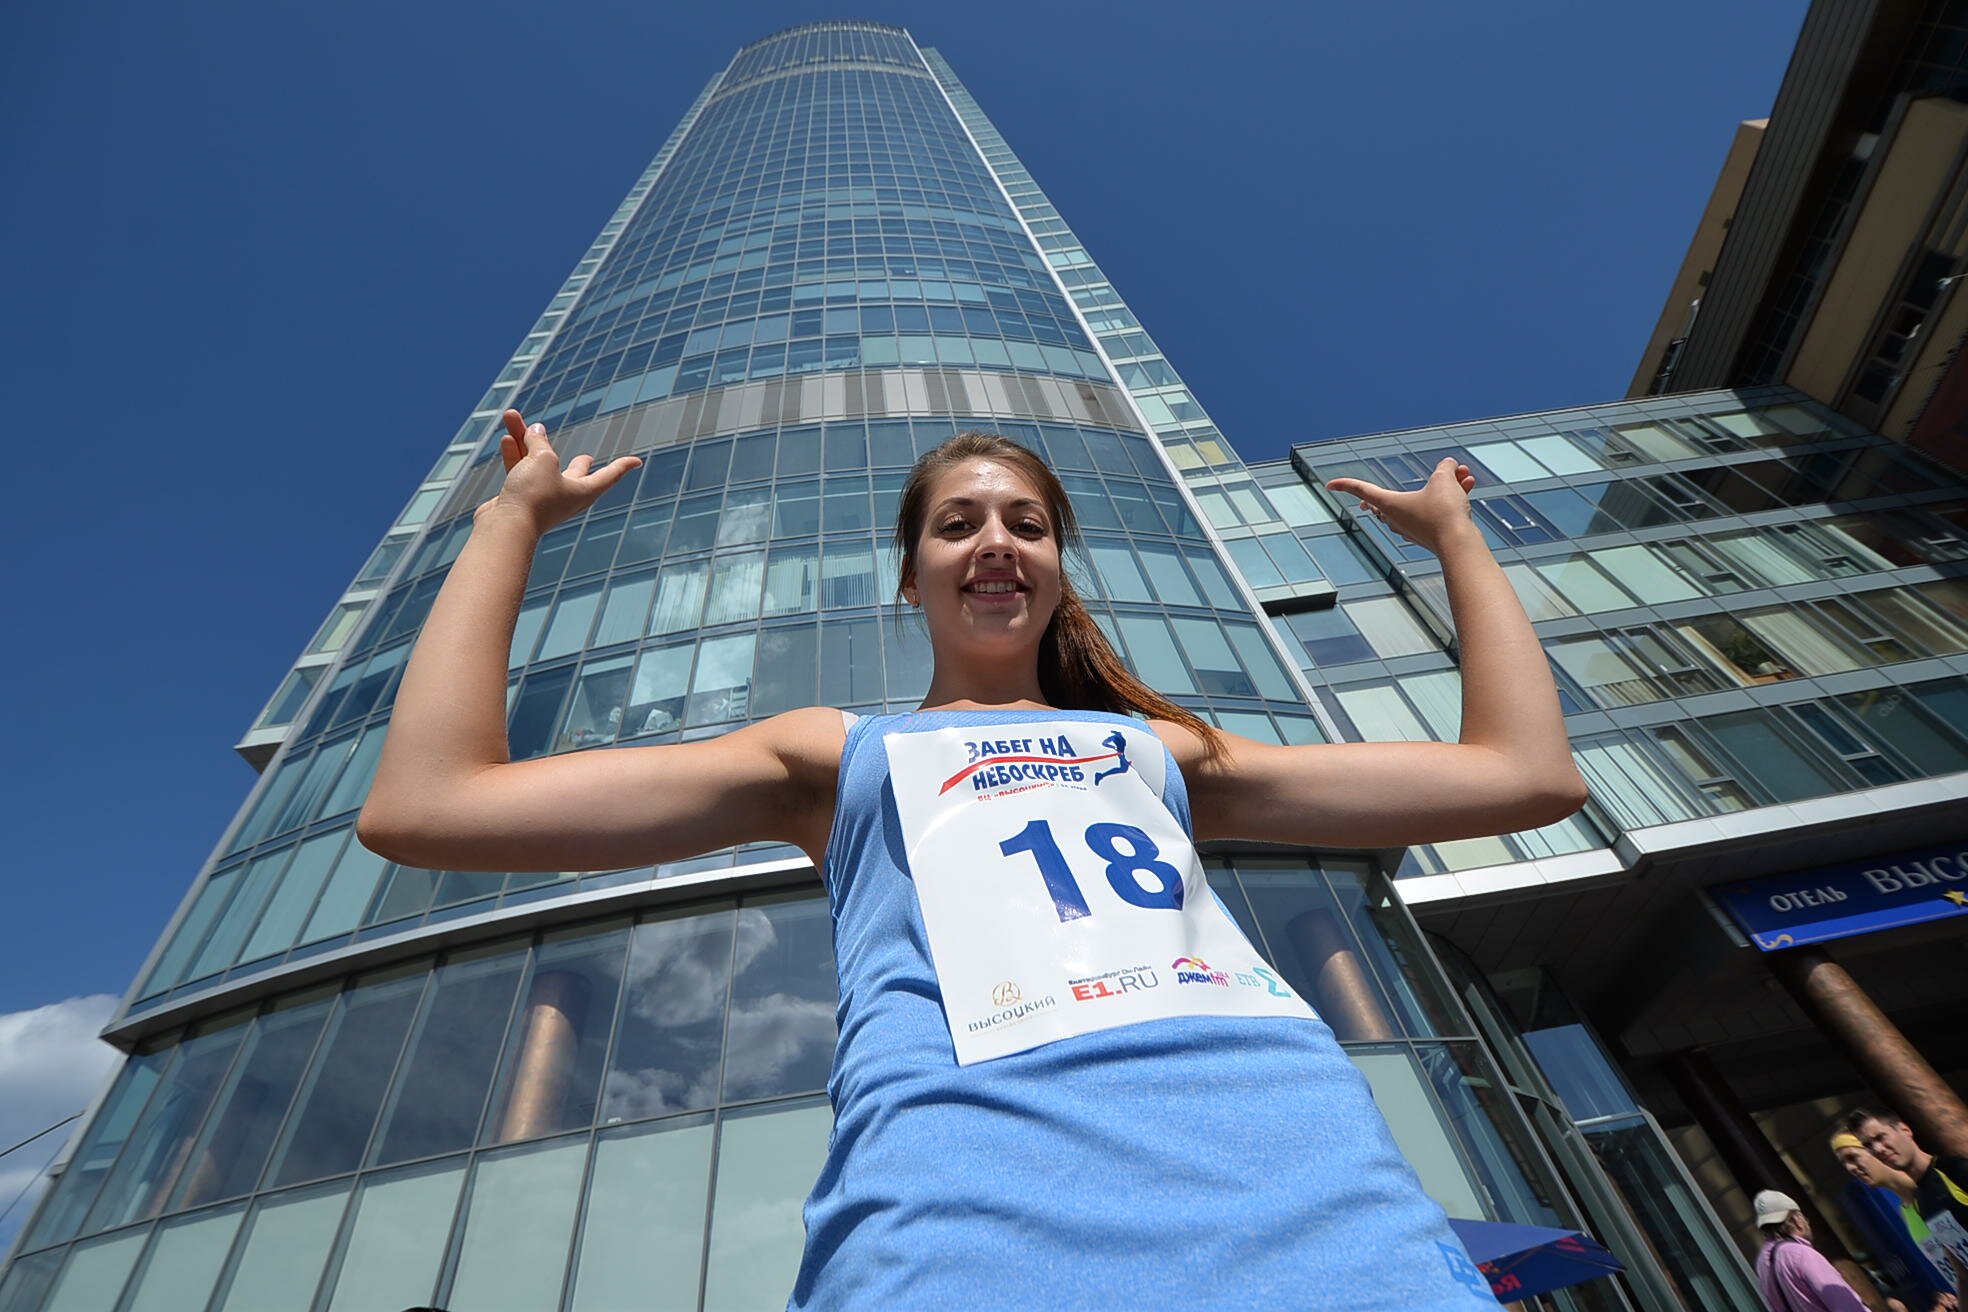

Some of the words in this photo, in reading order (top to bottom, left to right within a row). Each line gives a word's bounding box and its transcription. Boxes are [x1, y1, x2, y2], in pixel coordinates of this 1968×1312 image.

[964, 738, 1033, 764] ЗАБЕГ
[1038, 734, 1077, 758] НА
[972, 763, 1085, 791] НЕБОСКРЕБ
[999, 819, 1184, 923] 18
[1769, 885, 1848, 913] ОТЕЛЬ
[1071, 970, 1159, 1002] E1.RU
[968, 995, 1056, 1032] ВЫСОЦКИЙ
